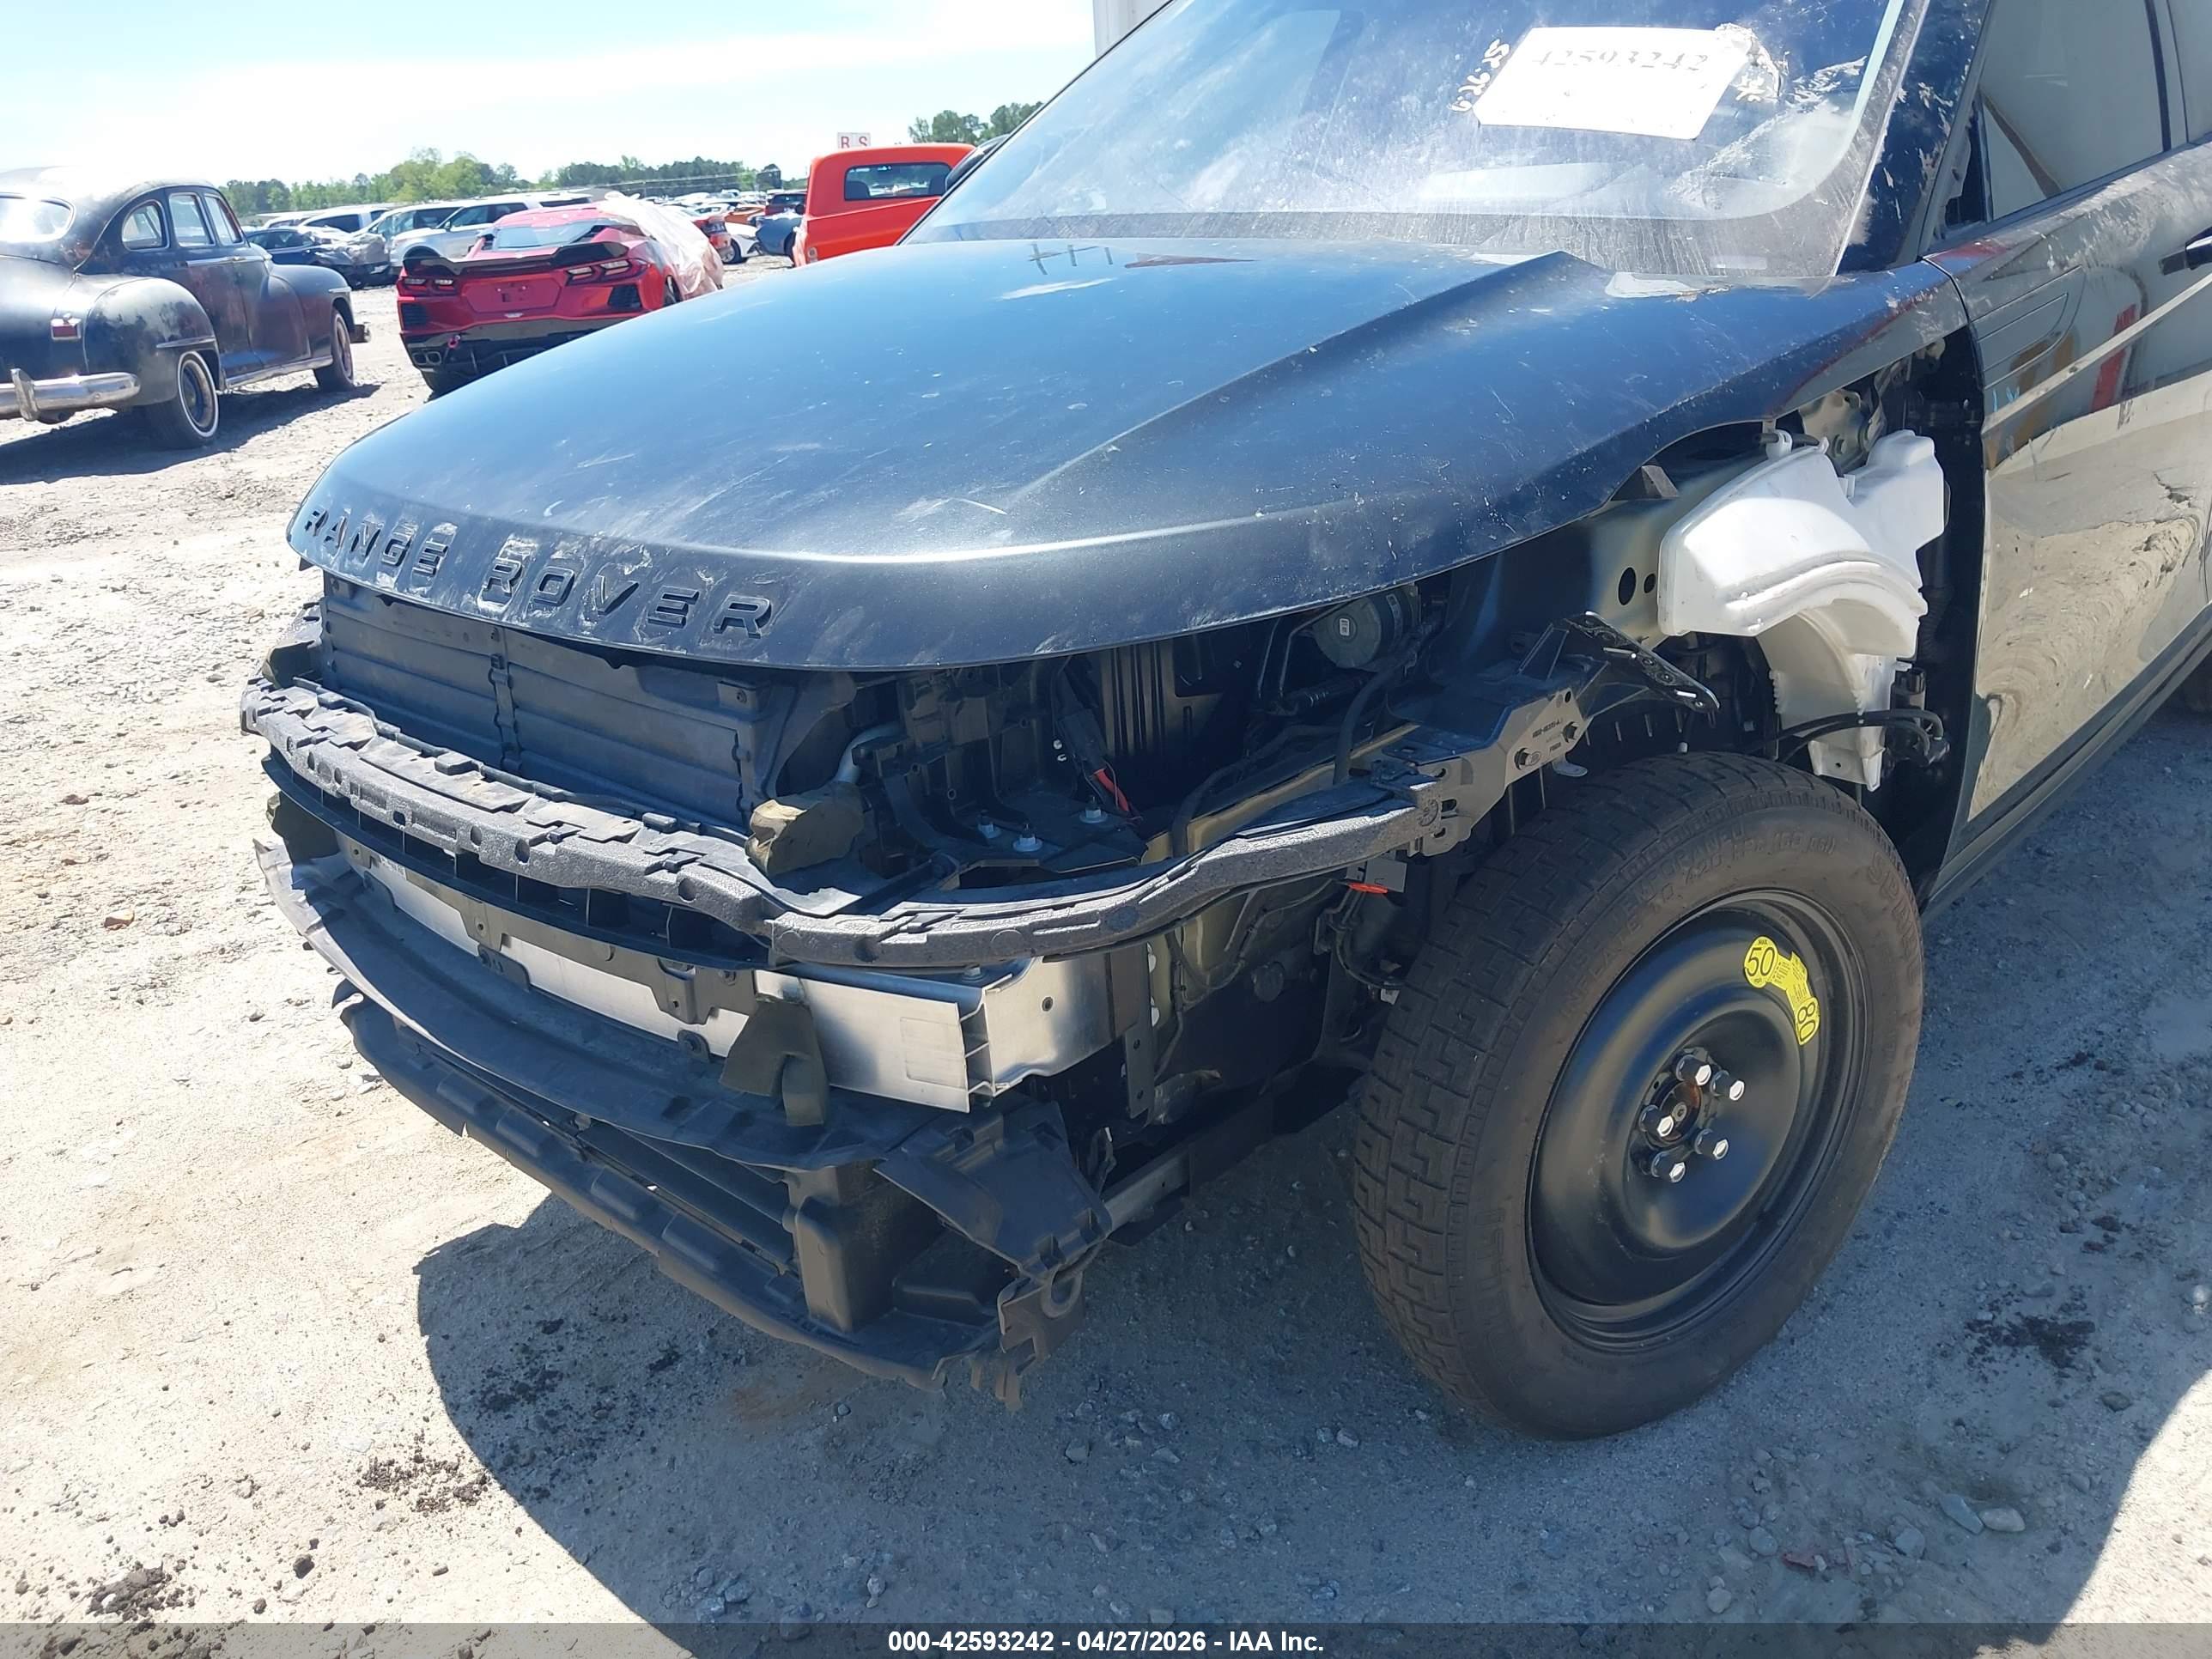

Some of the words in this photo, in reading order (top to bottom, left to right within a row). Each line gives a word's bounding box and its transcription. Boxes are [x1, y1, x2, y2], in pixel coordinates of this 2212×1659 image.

[306, 508, 454, 577] RANGE
[482, 556, 774, 640] ROVER
[1747, 947, 1775, 977] 50
[1797, 1001, 1816, 1042] 80
